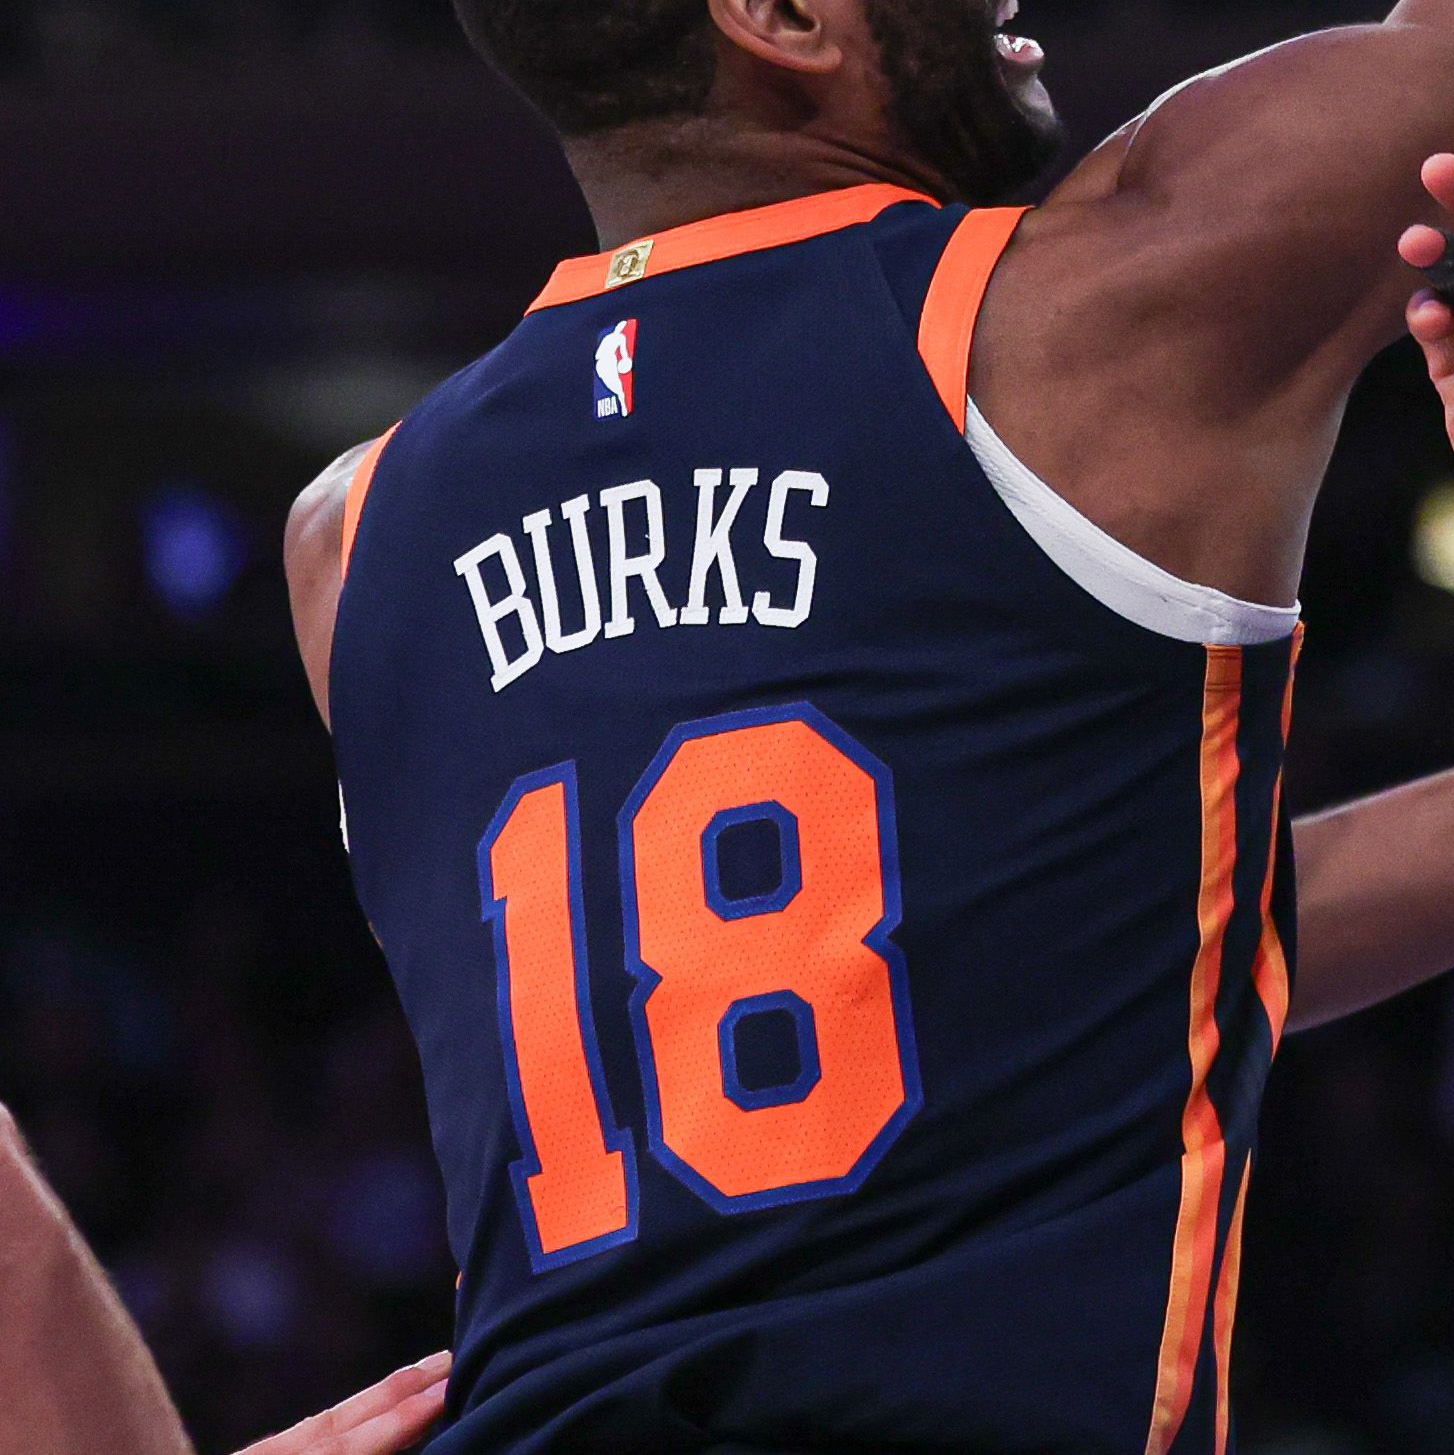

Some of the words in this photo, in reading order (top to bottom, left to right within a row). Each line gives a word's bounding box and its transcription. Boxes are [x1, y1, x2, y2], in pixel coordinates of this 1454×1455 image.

[597, 395, 619, 418] NBA
[453, 467, 830, 693] BURKS
[477, 701, 924, 1274] 18
